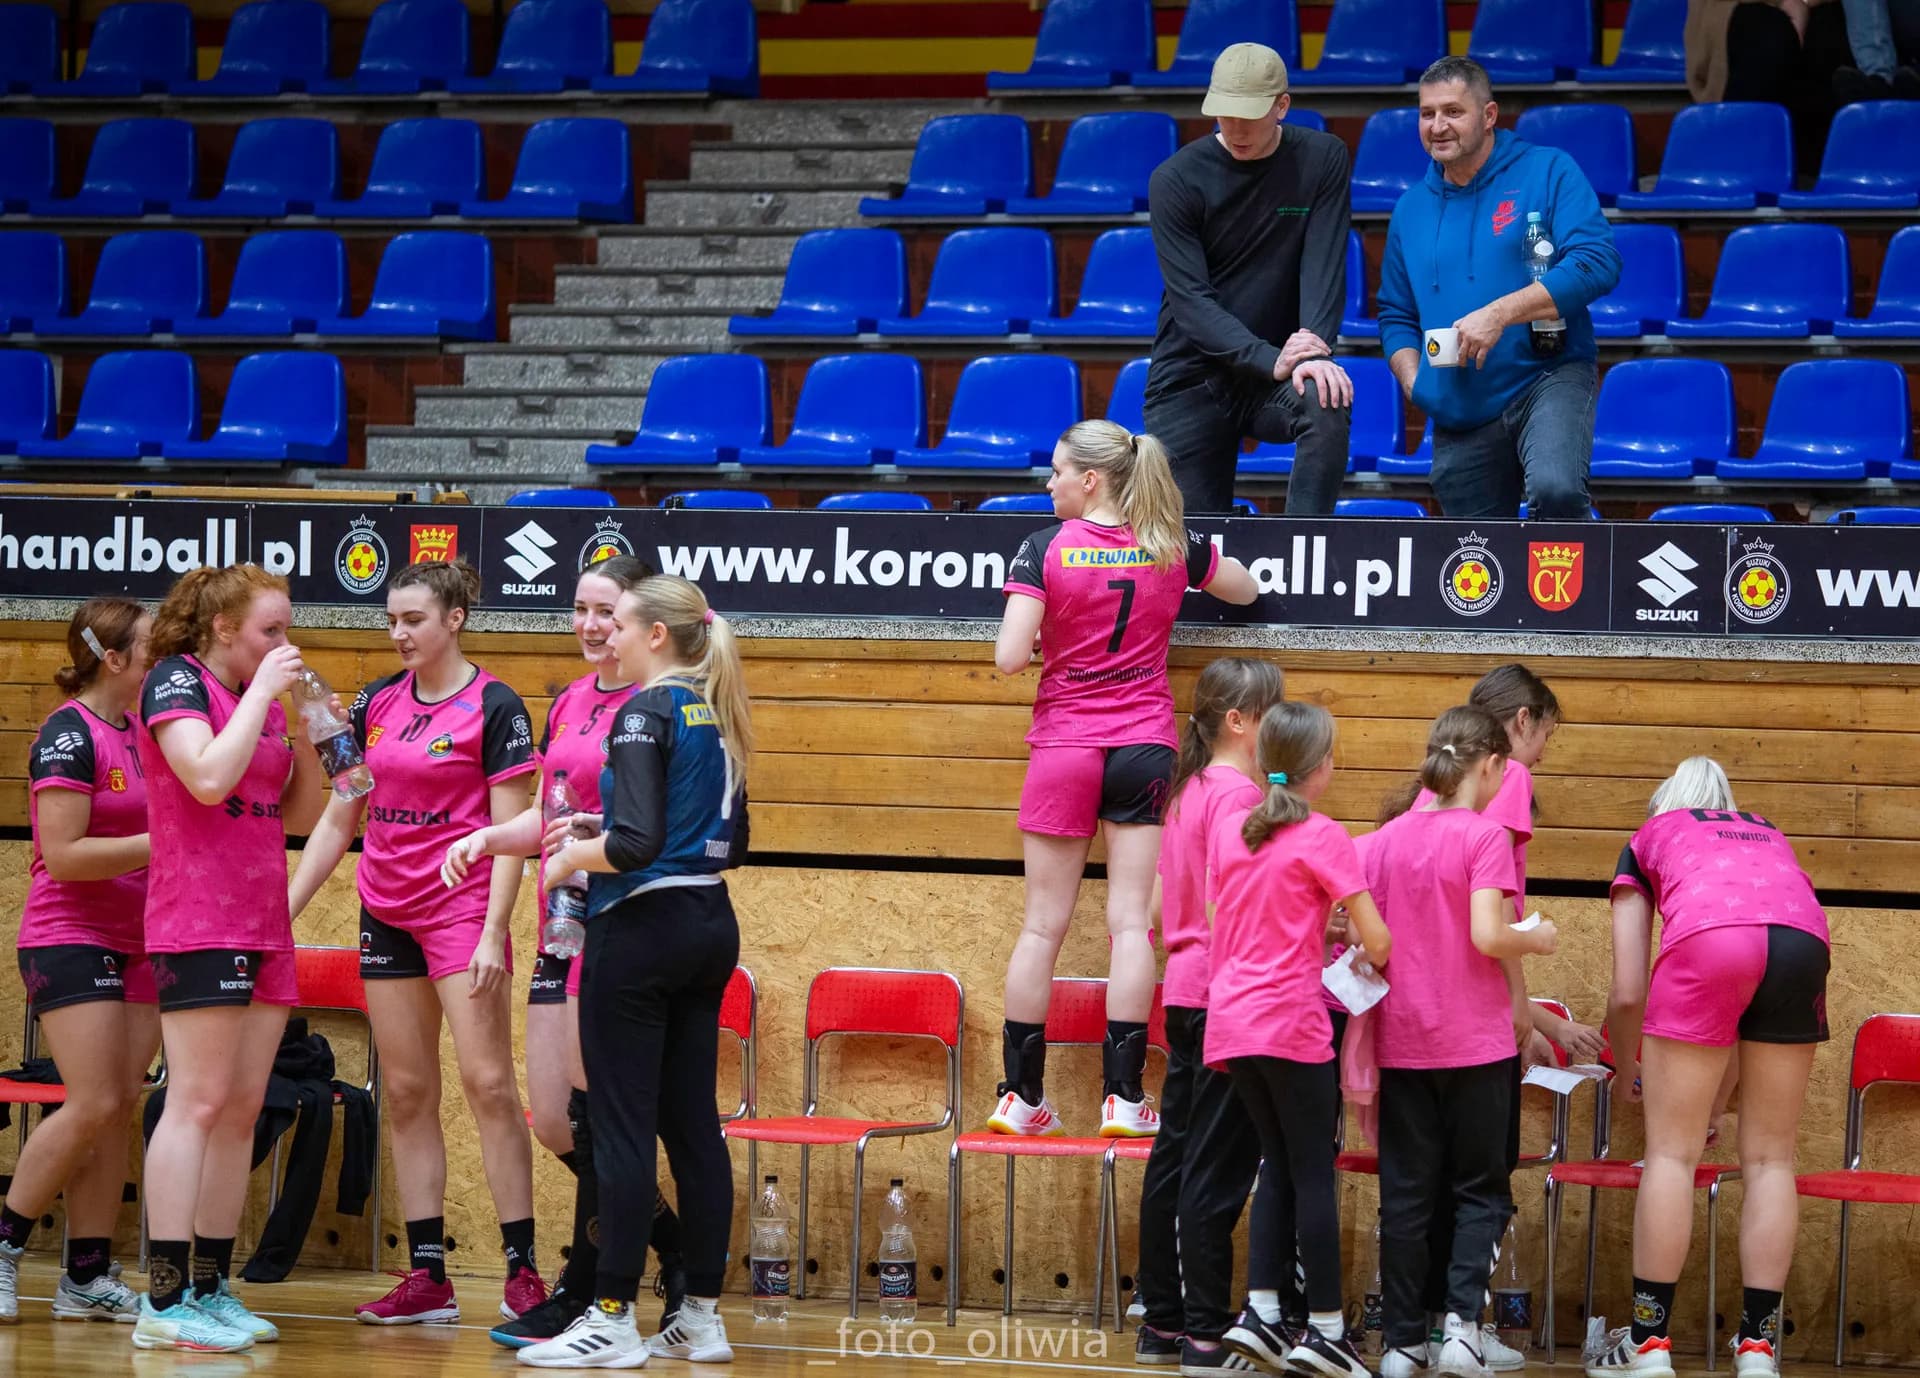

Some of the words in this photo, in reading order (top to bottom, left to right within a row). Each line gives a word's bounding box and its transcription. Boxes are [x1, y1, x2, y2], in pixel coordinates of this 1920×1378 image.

[352, 533, 373, 543] SUZUKI
[597, 536, 619, 545] SUZUKI
[1089, 548, 1156, 565] LEWIATA
[1460, 551, 1485, 562] SUZUKI
[1745, 557, 1771, 568] SUZUKI
[340, 565, 359, 589] KORONA
[359, 566, 384, 588] HANDBALL
[501, 583, 556, 596] SUZUKI
[1533, 569, 1573, 604] CK
[1445, 585, 1468, 610] KORONA
[1467, 586, 1497, 611] HANDBALL
[1730, 592, 1754, 618] KORONA
[1753, 593, 1785, 618] HANDBALL
[1107, 579, 1136, 654] 7
[1635, 609, 1698, 622] SUZUKI
[155, 681, 171, 693] Sun
[155, 687, 194, 701] Horizon
[579, 703, 607, 736] 5
[399, 713, 433, 743] 10
[506, 735, 532, 751] PROF
[613, 733, 656, 746] PROFIKA
[40, 746, 55, 756] Sun
[40, 753, 75, 764] Horizon
[374, 807, 451, 826] SUZUKI
